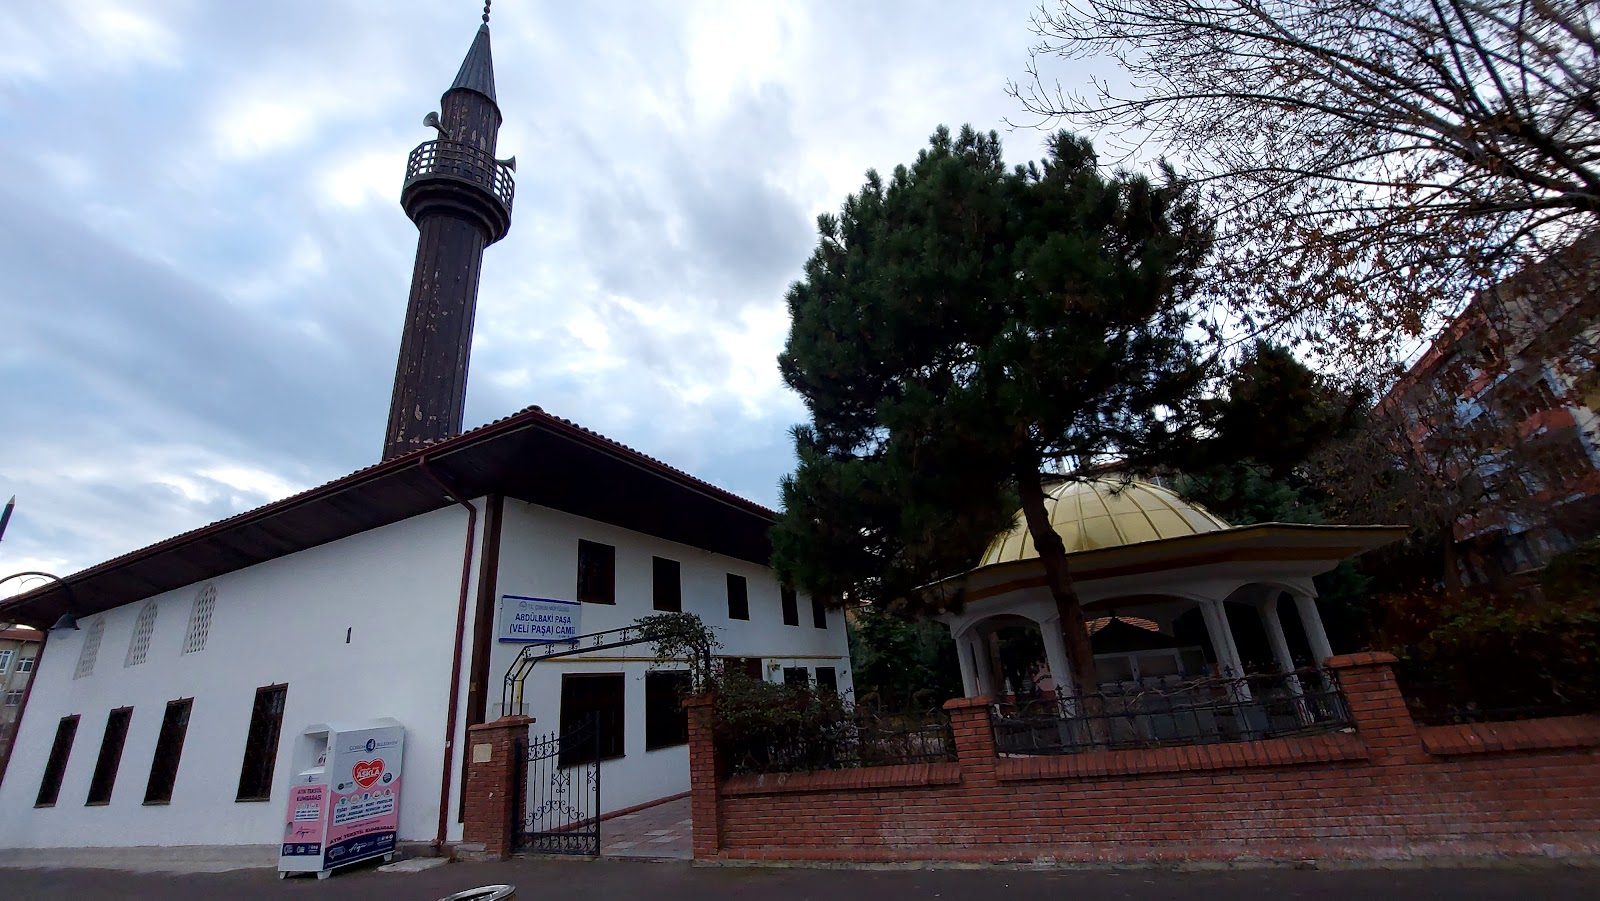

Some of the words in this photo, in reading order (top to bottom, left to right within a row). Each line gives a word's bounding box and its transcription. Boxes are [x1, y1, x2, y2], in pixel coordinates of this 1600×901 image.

[515, 612, 554, 623] ABDÜLBAKİ
[555, 615, 571, 625] PAŞA
[509, 622, 529, 634] (VELİ
[531, 625, 554, 636] PAŞA)
[329, 836, 343, 844] ATIK
